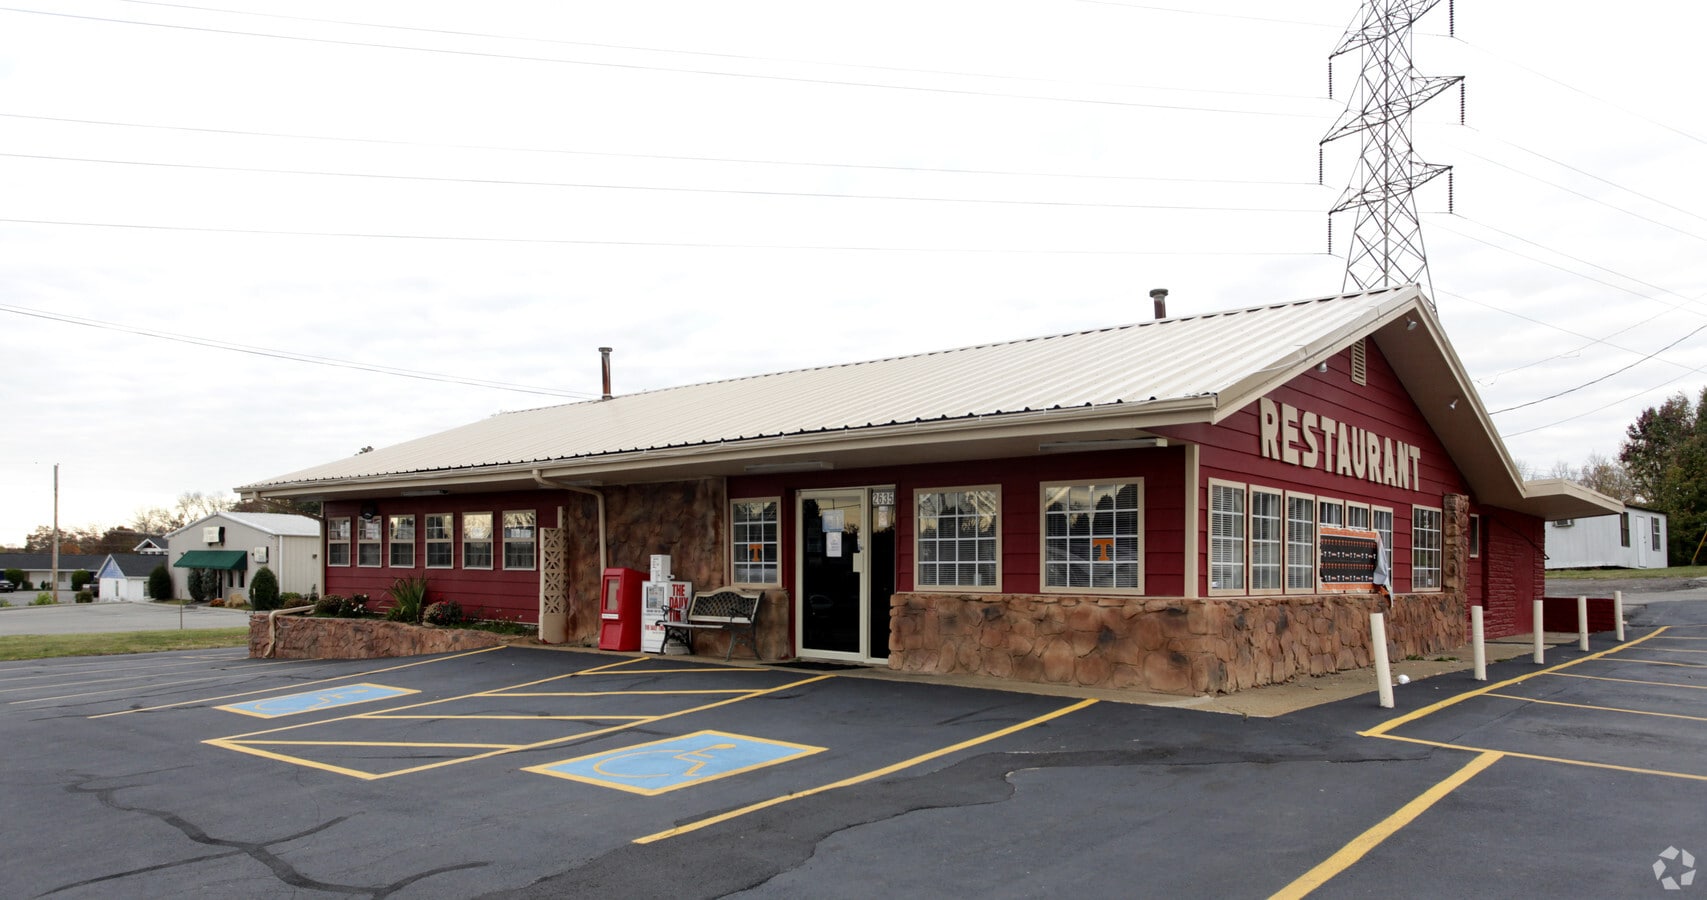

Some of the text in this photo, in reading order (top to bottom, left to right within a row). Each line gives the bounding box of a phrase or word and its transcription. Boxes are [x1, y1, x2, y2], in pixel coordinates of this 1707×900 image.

[1260, 396, 1421, 491] RESTAURANT
[872, 492, 895, 505] 2635
[748, 543, 763, 562] T
[1092, 538, 1114, 561] T
[672, 584, 686, 597] THE
[668, 596, 689, 609] DAILY
